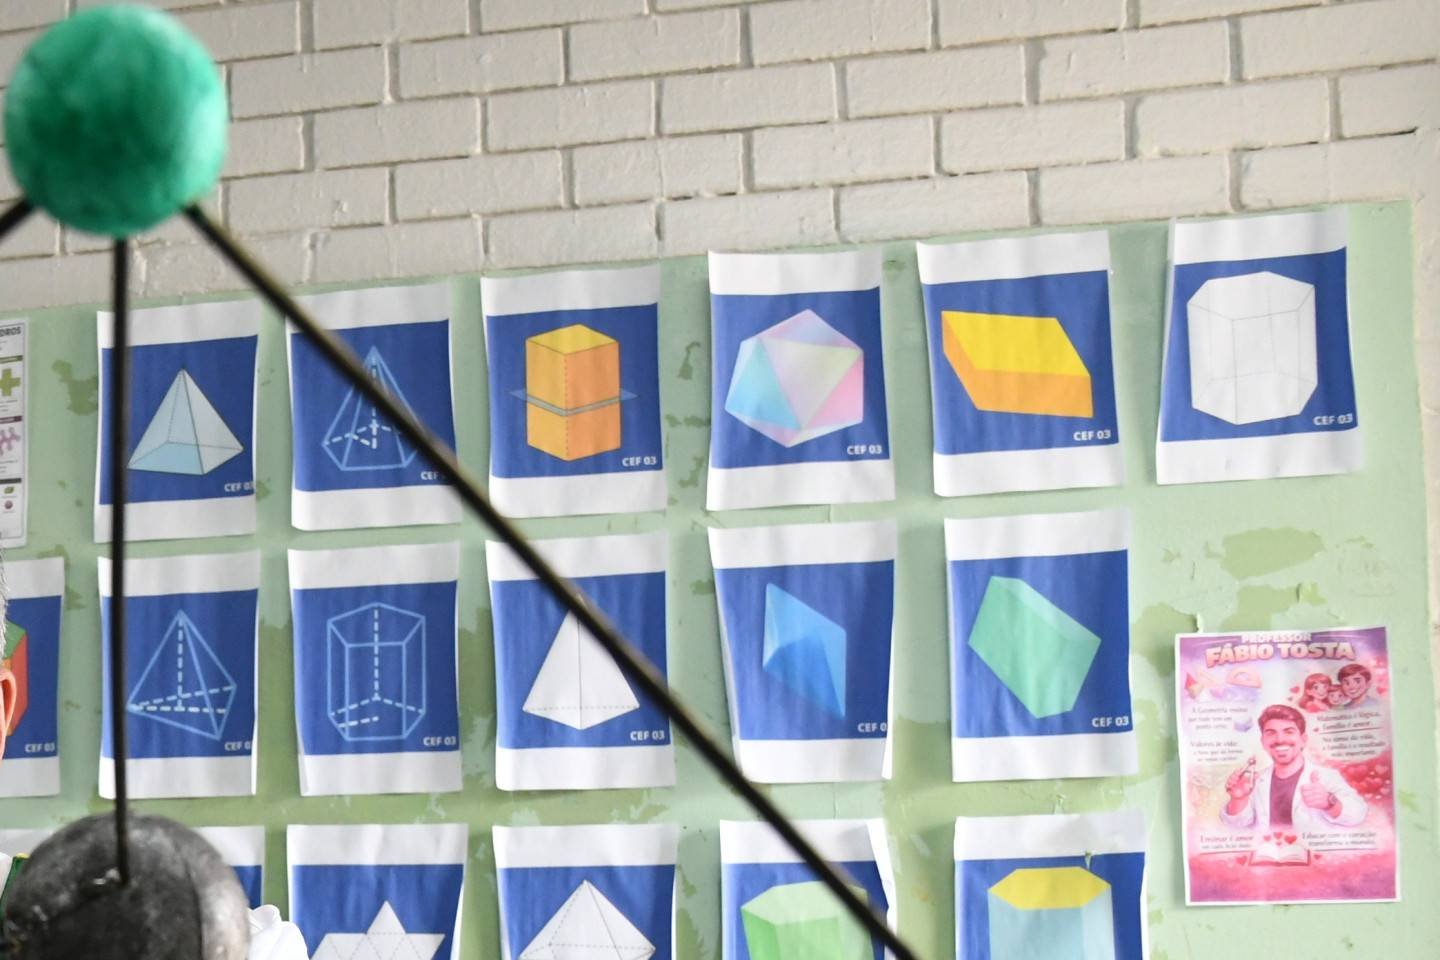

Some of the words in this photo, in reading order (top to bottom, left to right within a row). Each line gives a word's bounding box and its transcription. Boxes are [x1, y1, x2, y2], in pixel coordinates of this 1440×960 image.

[1313, 415, 1334, 426] CEF
[1337, 413, 1353, 424] 03
[1073, 431, 1094, 441] CEF
[1097, 429, 1111, 440] 03
[847, 445, 867, 455] CEF
[868, 444, 883, 454] 03
[622, 457, 641, 467] CEF
[643, 456, 657, 466] 03
[224, 483, 241, 492] CEF
[1241, 633, 1312, 643] PROFESSOR
[1205, 643, 1275, 668] FÁBIO
[1277, 642, 1356, 660] TOSTA
[857, 722, 877, 732] CEF
[1092, 717, 1112, 728] CEF
[1115, 716, 1129, 726] 03
[423, 736, 441, 746] CEF
[444, 736, 457, 746] 03
[630, 730, 649, 741] CEF
[652, 730, 665, 740] 03
[24, 743, 42, 753] CEF
[224, 741, 243, 751] CEF
